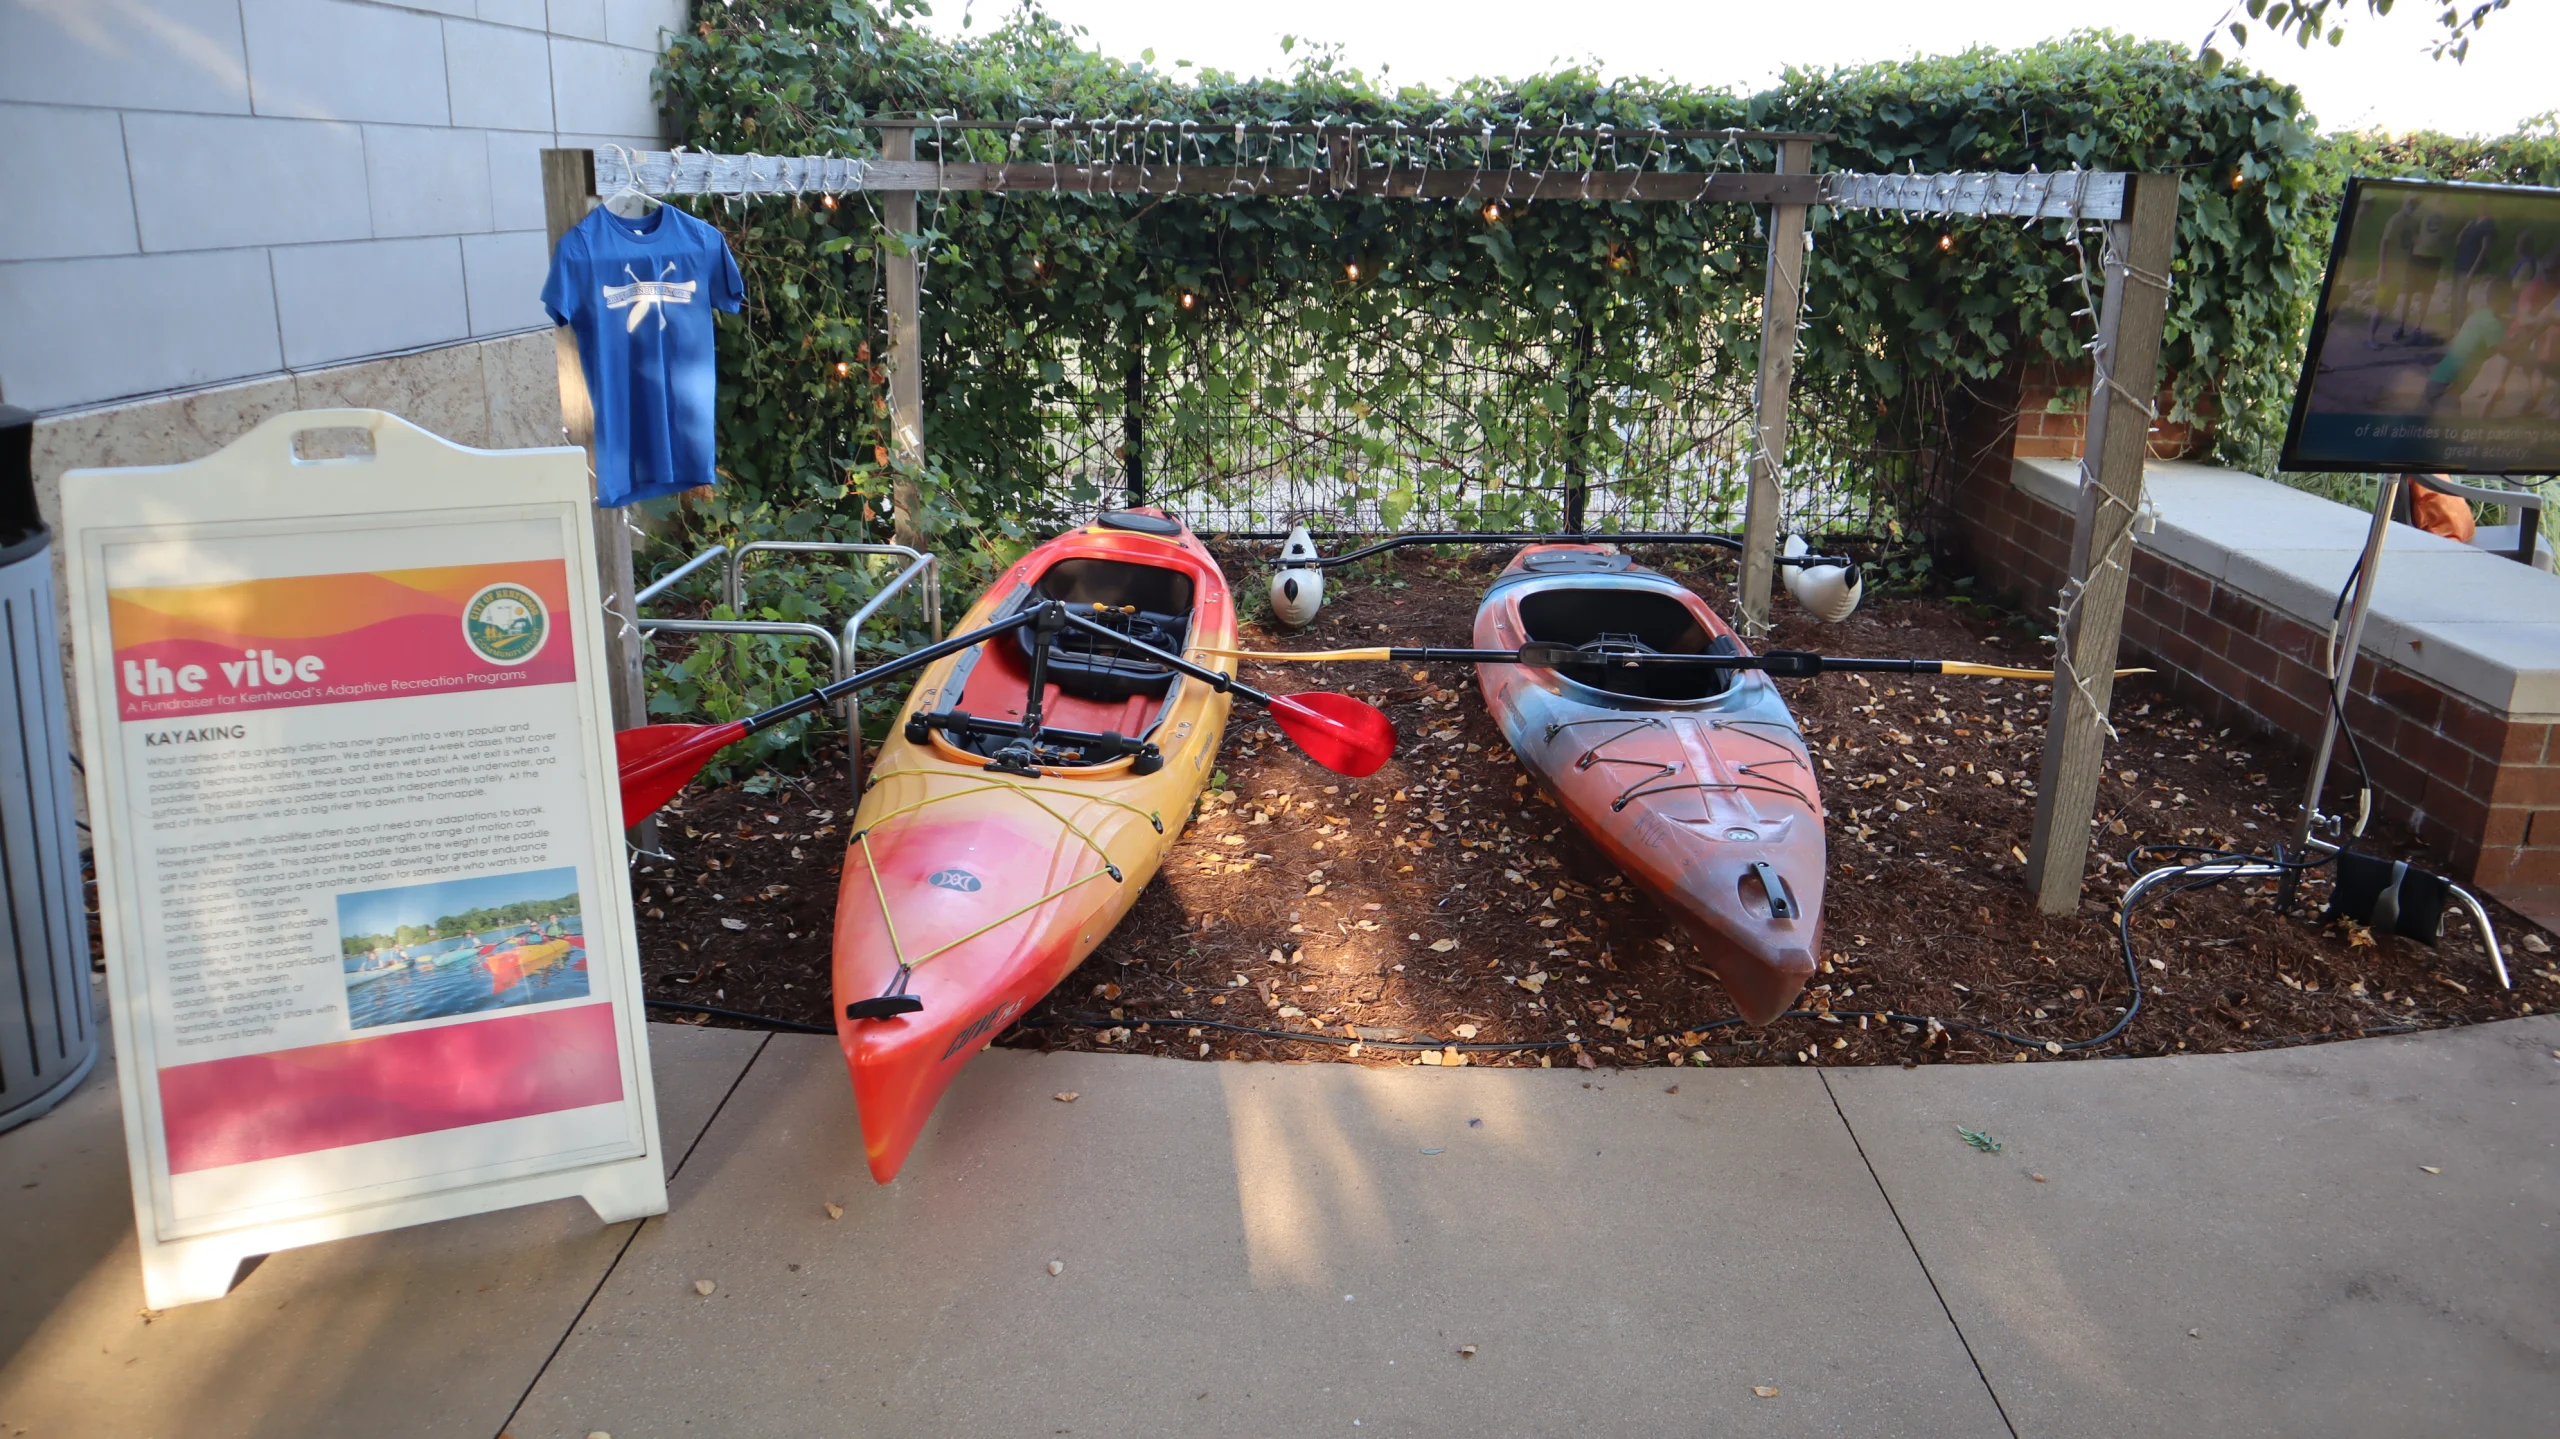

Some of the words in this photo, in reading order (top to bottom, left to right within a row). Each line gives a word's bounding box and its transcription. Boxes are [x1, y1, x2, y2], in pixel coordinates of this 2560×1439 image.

[2355, 423, 2371, 437] of
[2373, 424, 2388, 437] all
[2391, 424, 2440, 439] abilities
[2445, 427, 2458, 439] to
[2461, 427, 2483, 443] get
[2444, 445, 2478, 459] great
[470, 601, 485, 620] CITY
[496, 590, 540, 616] KENTWOOD
[476, 638, 522, 657] COMMUNITY
[123, 658, 208, 697] the
[219, 649, 325, 688] vibe
[126, 704, 138, 714] A
[142, 698, 214, 711] Fundraiser
[218, 694, 235, 705] for
[240, 687, 322, 703] Kentwood's
[325, 680, 388, 697] Adaptive
[391, 675, 463, 690] Recreation
[467, 670, 527, 685] Programs
[145, 725, 246, 747] KAYAKING
[238, 757, 288, 772] kayaking
[290, 754, 340, 767] program.
[342, 750, 360, 759] We
[362, 748, 387, 758] offer
[388, 744, 426, 755] several
[428, 740, 465, 751] 4-week
[467, 737, 502, 747] classes
[505, 735, 526, 744] that
[263, 744, 297, 757] yearly
[298, 741, 327, 751] clinic
[328, 739, 349, 748] has
[375, 735, 409, 746] grown
[410, 731, 430, 741] into
[443, 730, 465, 740] very
[466, 724, 507, 737] popular
[509, 722, 530, 731] and
[148, 779, 201, 794] paddling
[348, 762, 372, 771] and
[371, 760, 399, 769] even
[401, 757, 422, 766] wet
[423, 754, 449, 764] exits!
[451, 753, 459, 761] A
[461, 751, 481, 760] wet
[483, 749, 501, 758] exit
[502, 748, 510, 756] is
[511, 745, 540, 755] when
[150, 792, 196, 806] paddler
[266, 780, 313, 794] capsizes
[314, 777, 339, 787] their
[371, 772, 394, 782] exits
[396, 770, 414, 779] the
[415, 767, 440, 777] boat
[443, 764, 469, 774] while
[535, 756, 556, 765] and
[294, 790, 338, 804] paddler
[339, 789, 361, 797] can
[363, 784, 395, 797] kayak
[396, 776, 472, 793] independently
[474, 773, 505, 785] safely.
[522, 769, 539, 778] the
[309, 803, 330, 815] big
[329, 801, 353, 811] river
[355, 799, 372, 810] trip
[374, 795, 405, 806] down
[407, 793, 424, 803] the
[426, 787, 486, 803] Thornapple.
[190, 839, 231, 853] people
[233, 836, 256, 846] with
[258, 830, 313, 844] disabilities
[314, 827, 344, 837] often
[344, 825, 361, 834] do
[382, 819, 411, 830] need
[413, 819, 434, 829] any
[435, 810, 498, 826] adaptations
[500, 809, 510, 817] to
[512, 805, 545, 818] kayak.
[270, 843, 308, 855] limited
[308, 841, 343, 853] upper
[342, 836, 373, 849] body
[374, 831, 416, 846] strength
[430, 828, 463, 839] range
[464, 825, 476, 833] of
[477, 820, 513, 832] motion
[1634, 813, 1668, 848] KYLE
[280, 857, 300, 866] This
[300, 851, 352, 866] adaptive
[352, 846, 393, 860] paddle
[394, 843, 422, 853] takes
[424, 841, 442, 850] the
[443, 837, 479, 850] weight
[480, 835, 491, 843] of
[493, 833, 510, 842] the
[512, 829, 550, 842] paddle
[159, 884, 175, 893] off
[261, 871, 286, 881] and
[338, 863, 357, 872] the
[389, 854, 434, 869] allowing
[434, 852, 449, 861] for
[451, 848, 489, 861] greater
[491, 841, 547, 854] endurance
[235, 883, 293, 899] Outriggers
[293, 882, 314, 890] are
[314, 875, 358, 888] another
[358, 871, 394, 885] option
[412, 865, 461, 876] someone
[462, 860, 485, 870] who
[487, 856, 517, 867] wants
[519, 855, 530, 863] to
[532, 853, 546, 862] be
[250, 898, 275, 908] their
[244, 923, 276, 934] These
[277, 916, 329, 930] inflatable
[264, 931, 314, 947] adjusted
[263, 943, 314, 960] paddlers
[223, 999, 273, 1016] kayaking
[174, 1019, 225, 1033] fantastic
